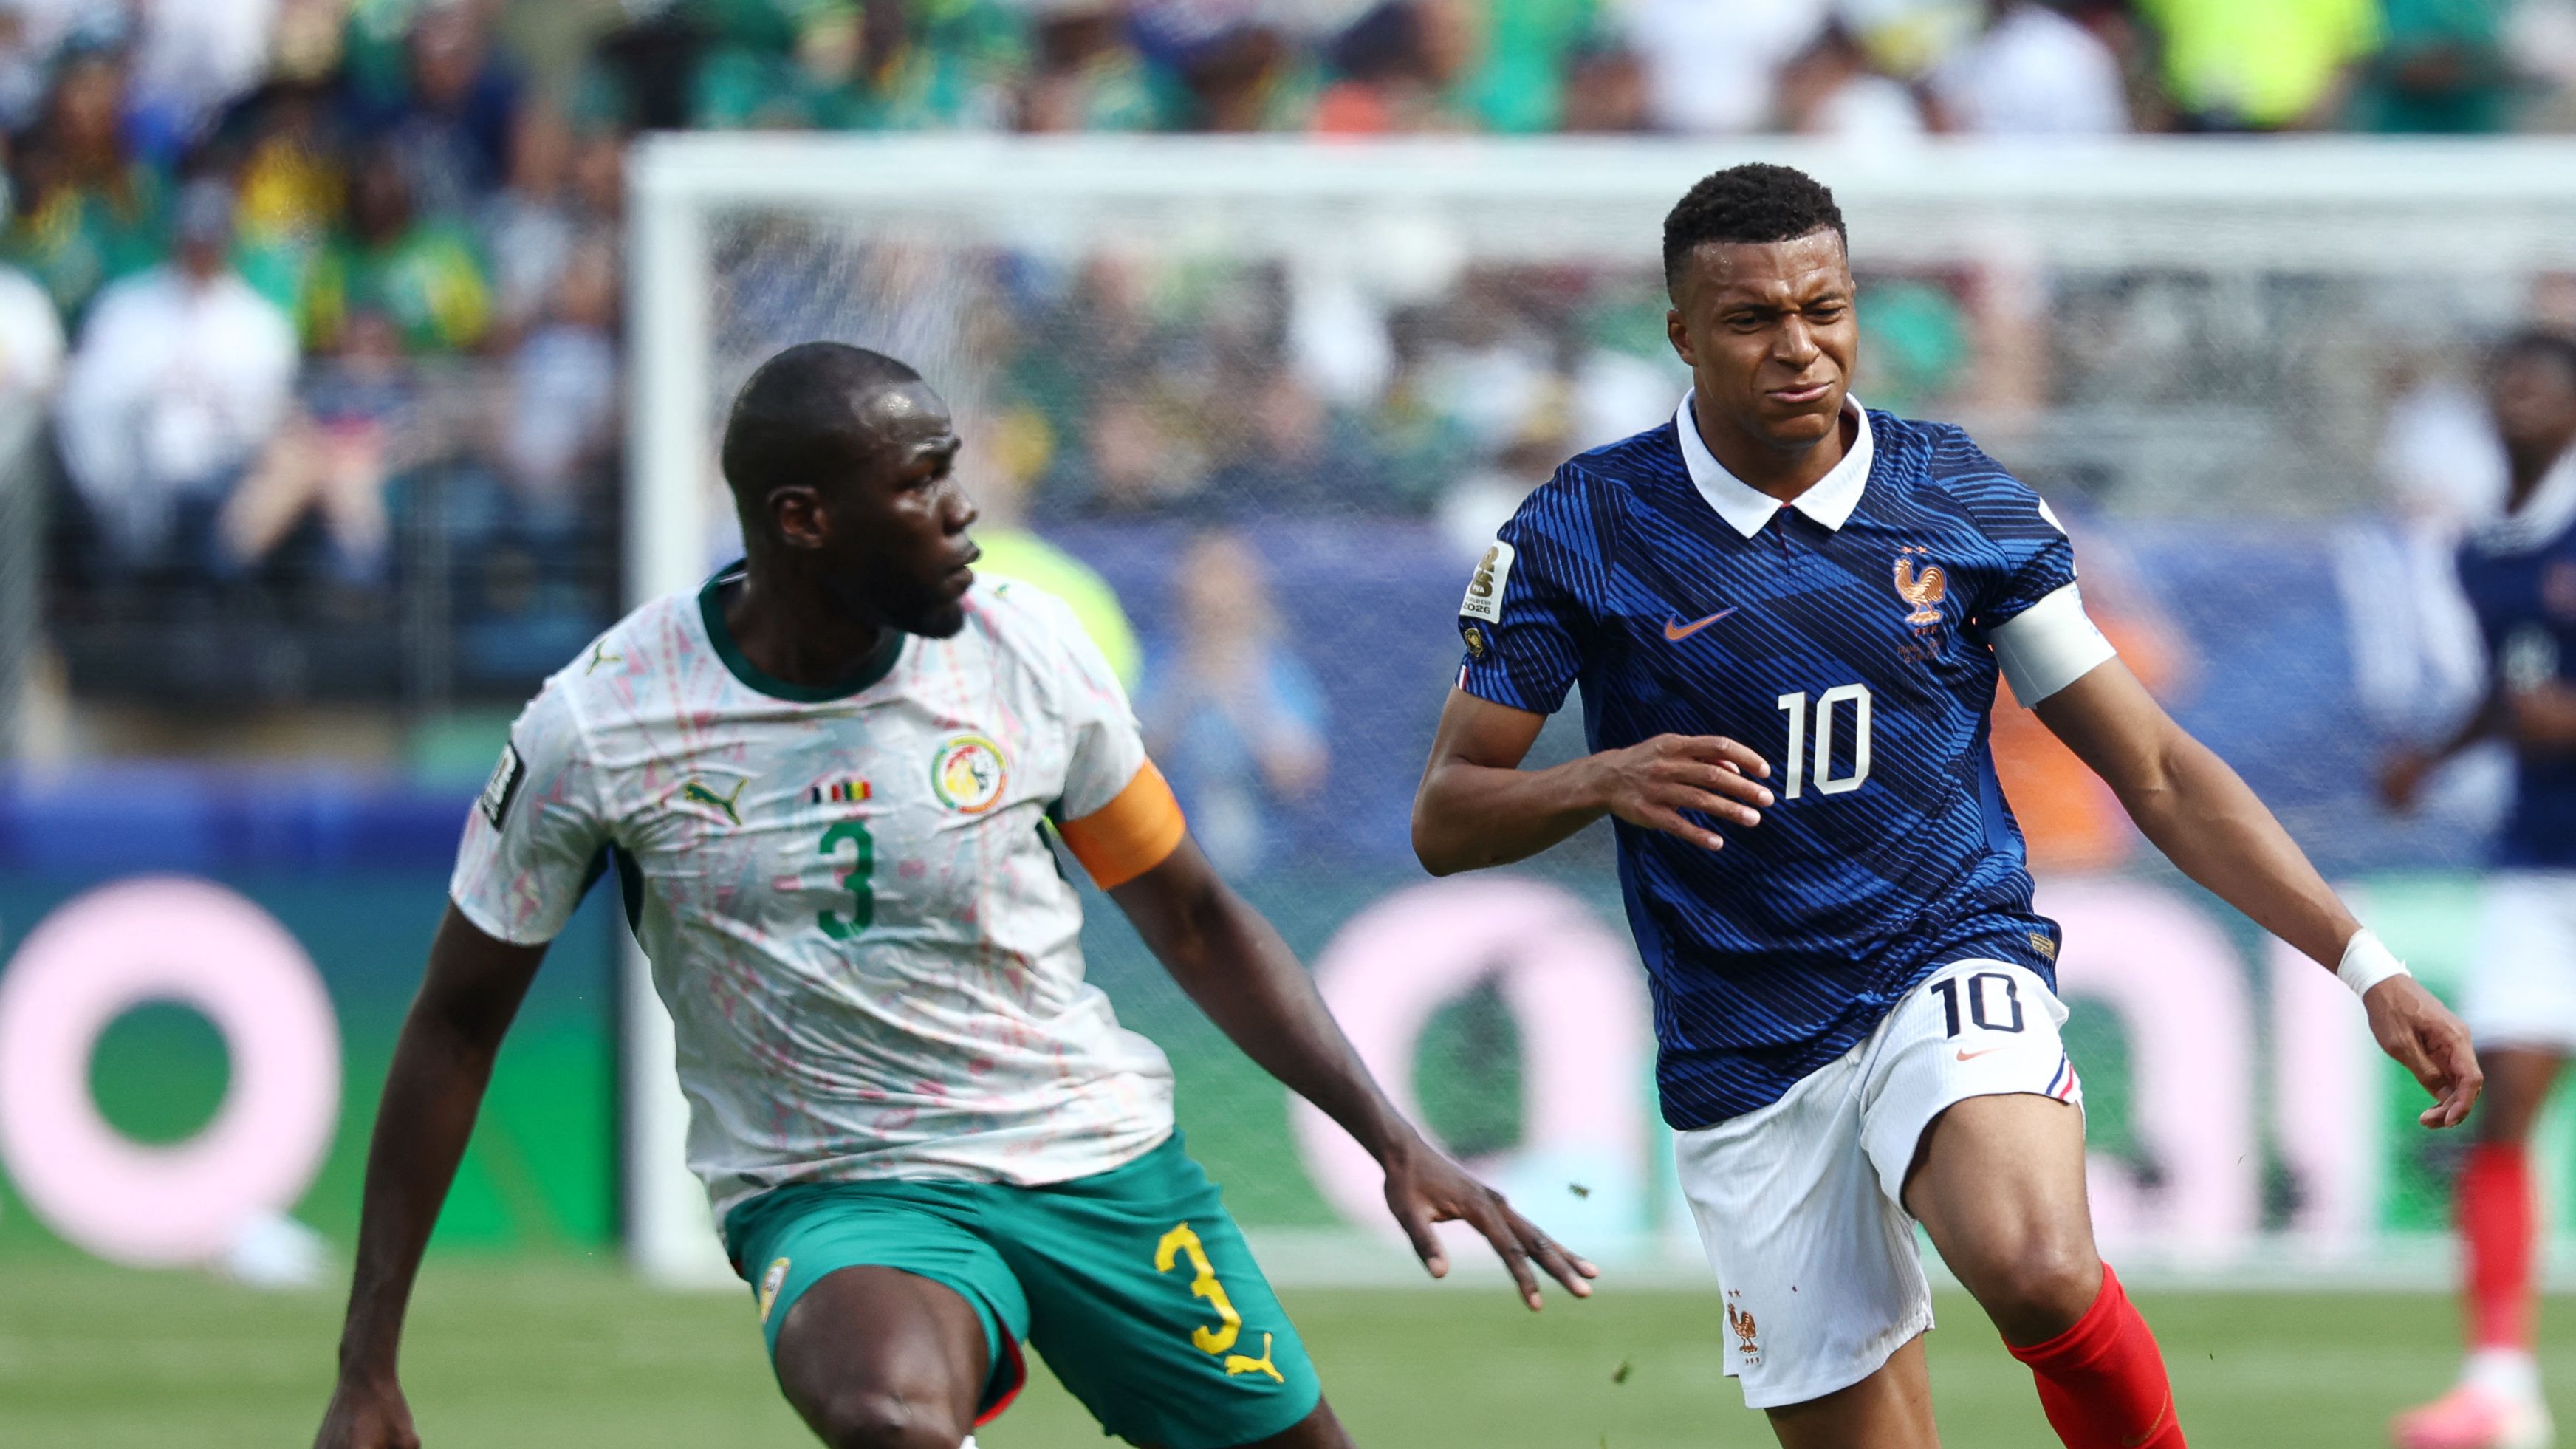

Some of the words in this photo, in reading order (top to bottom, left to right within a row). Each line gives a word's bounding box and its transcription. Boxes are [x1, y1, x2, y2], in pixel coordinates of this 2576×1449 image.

[1463, 601, 1490, 614] 2026
[1778, 682, 1871, 799] 10
[818, 821, 873, 940] 3
[1930, 972, 2026, 1040] 10
[1154, 1222, 1241, 1354] 3
